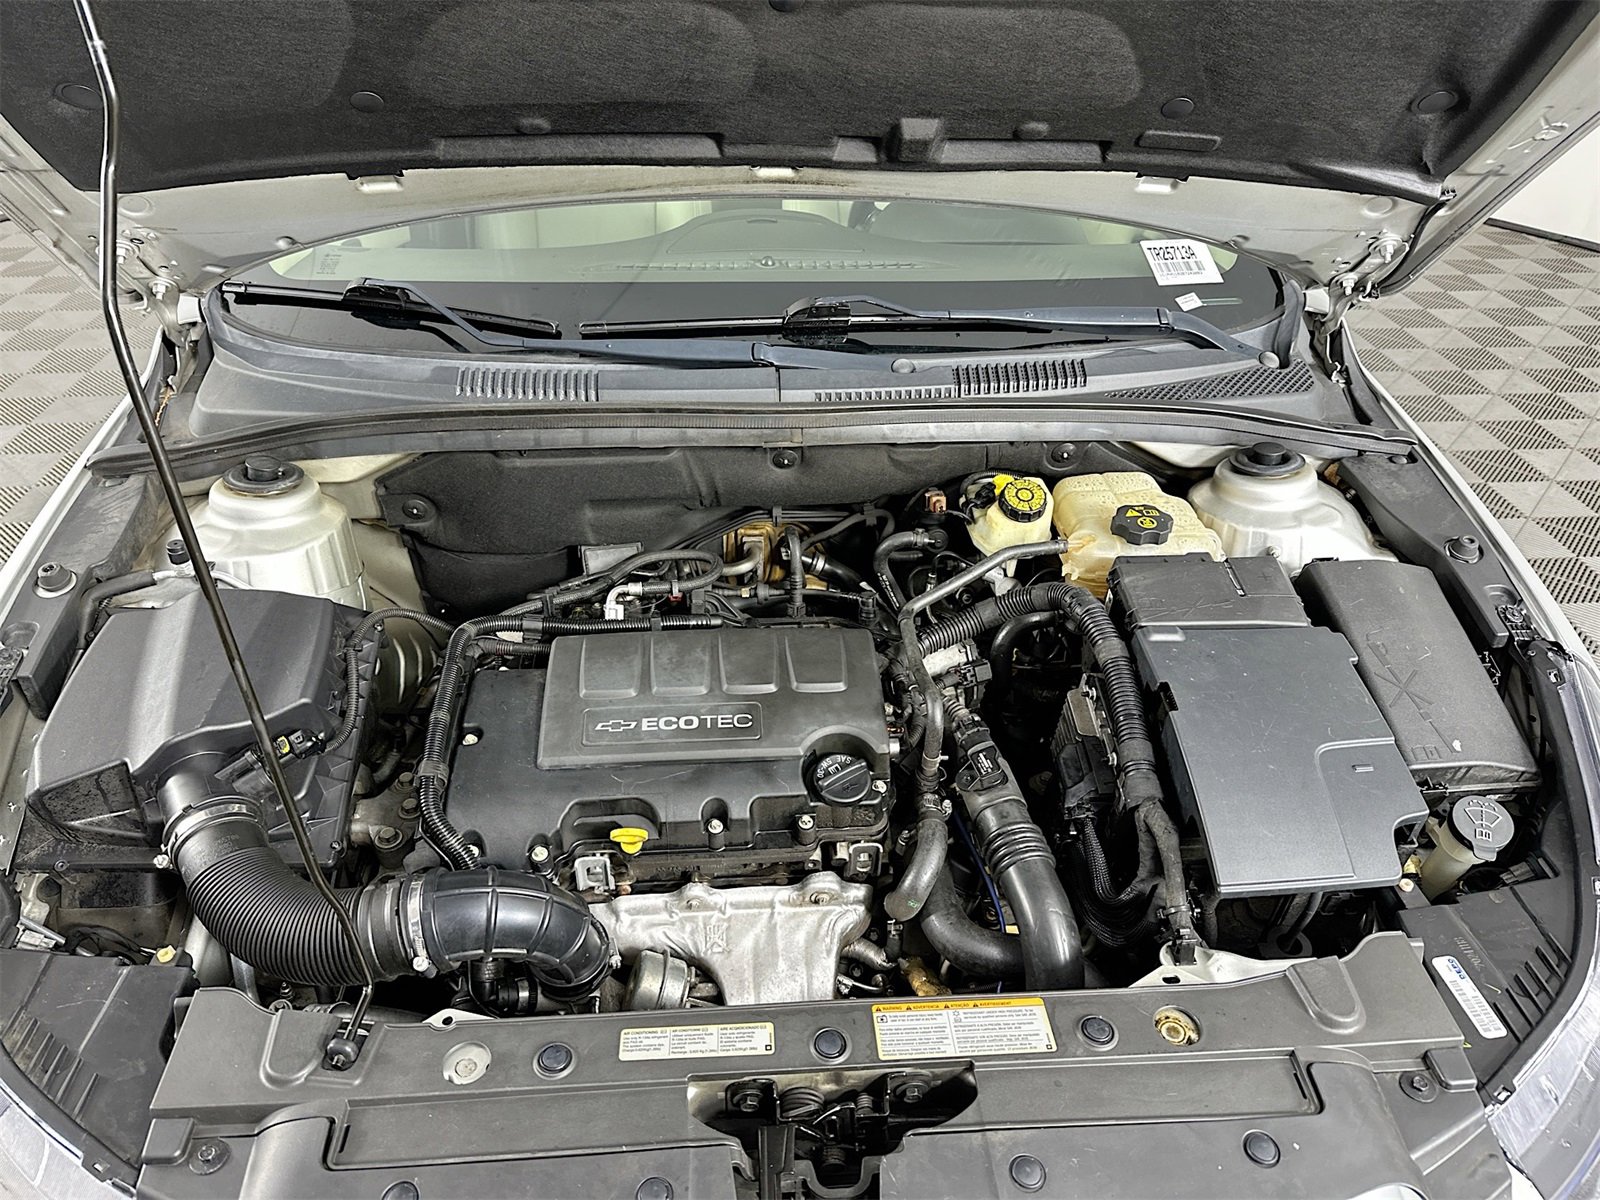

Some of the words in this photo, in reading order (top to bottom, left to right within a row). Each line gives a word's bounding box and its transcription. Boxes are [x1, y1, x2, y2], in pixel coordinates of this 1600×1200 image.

[1147, 245, 1198, 261] TR25713A
[641, 713, 754, 731] ECOTEC
[836, 754, 852, 764] SAE
